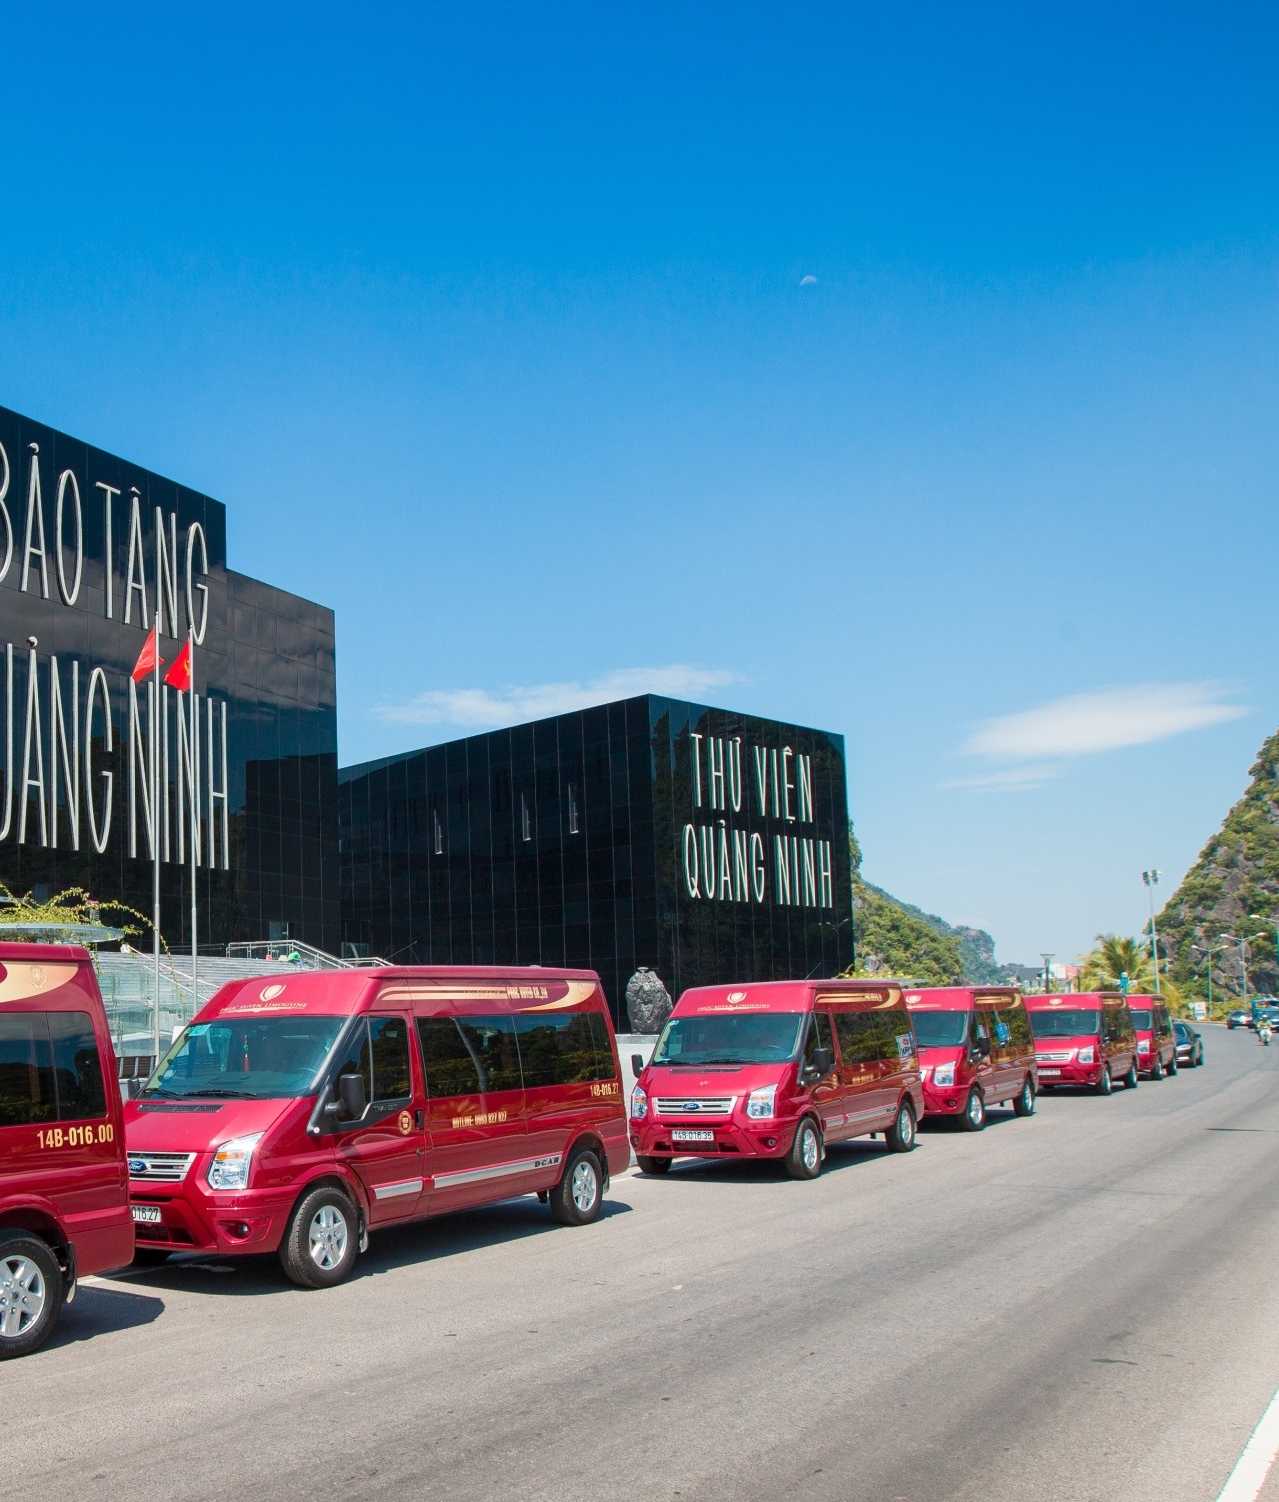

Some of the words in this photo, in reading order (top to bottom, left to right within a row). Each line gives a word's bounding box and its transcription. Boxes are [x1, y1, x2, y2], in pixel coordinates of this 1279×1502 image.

[95, 482, 209, 646] TÀNG
[128, 676, 229, 870] NINH
[753, 746, 813, 824] VIỆN
[682, 820, 765, 903] QUẢNG
[773, 835, 832, 908] NINH
[37, 1124, 114, 1149] 14B-016.00
[534, 1157, 560, 1168] DCAR
